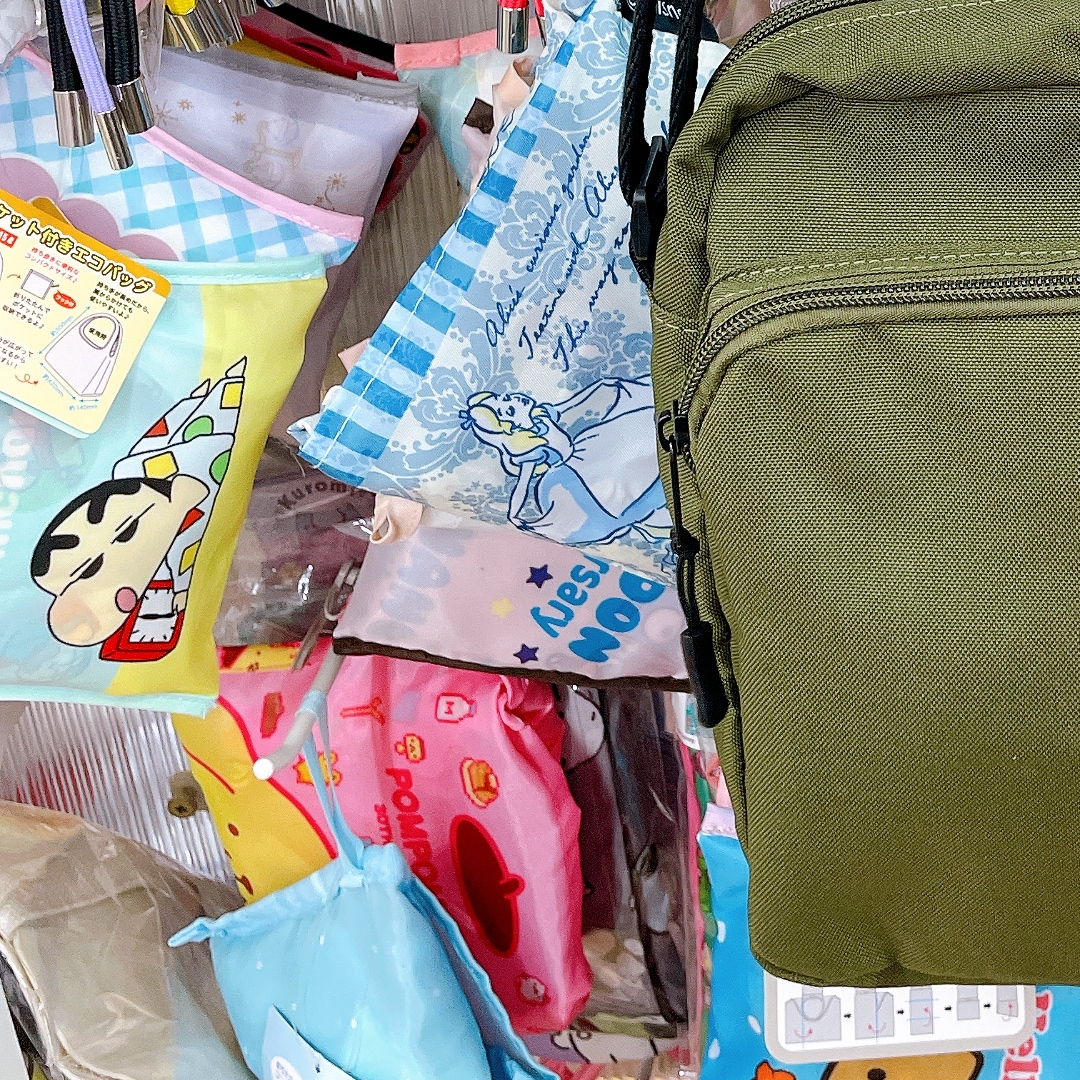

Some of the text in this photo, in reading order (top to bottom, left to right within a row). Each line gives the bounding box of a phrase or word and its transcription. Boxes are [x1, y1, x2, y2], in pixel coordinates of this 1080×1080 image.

[525, 203, 561, 272] curious
[562, 126, 593, 199] garden
[565, 227, 591, 282] with
[12, 301, 43, 320] ポケットに
[13, 292, 51, 313] 折りたたんで
[553, 318, 591, 372] This
[588, 257, 619, 314] way
